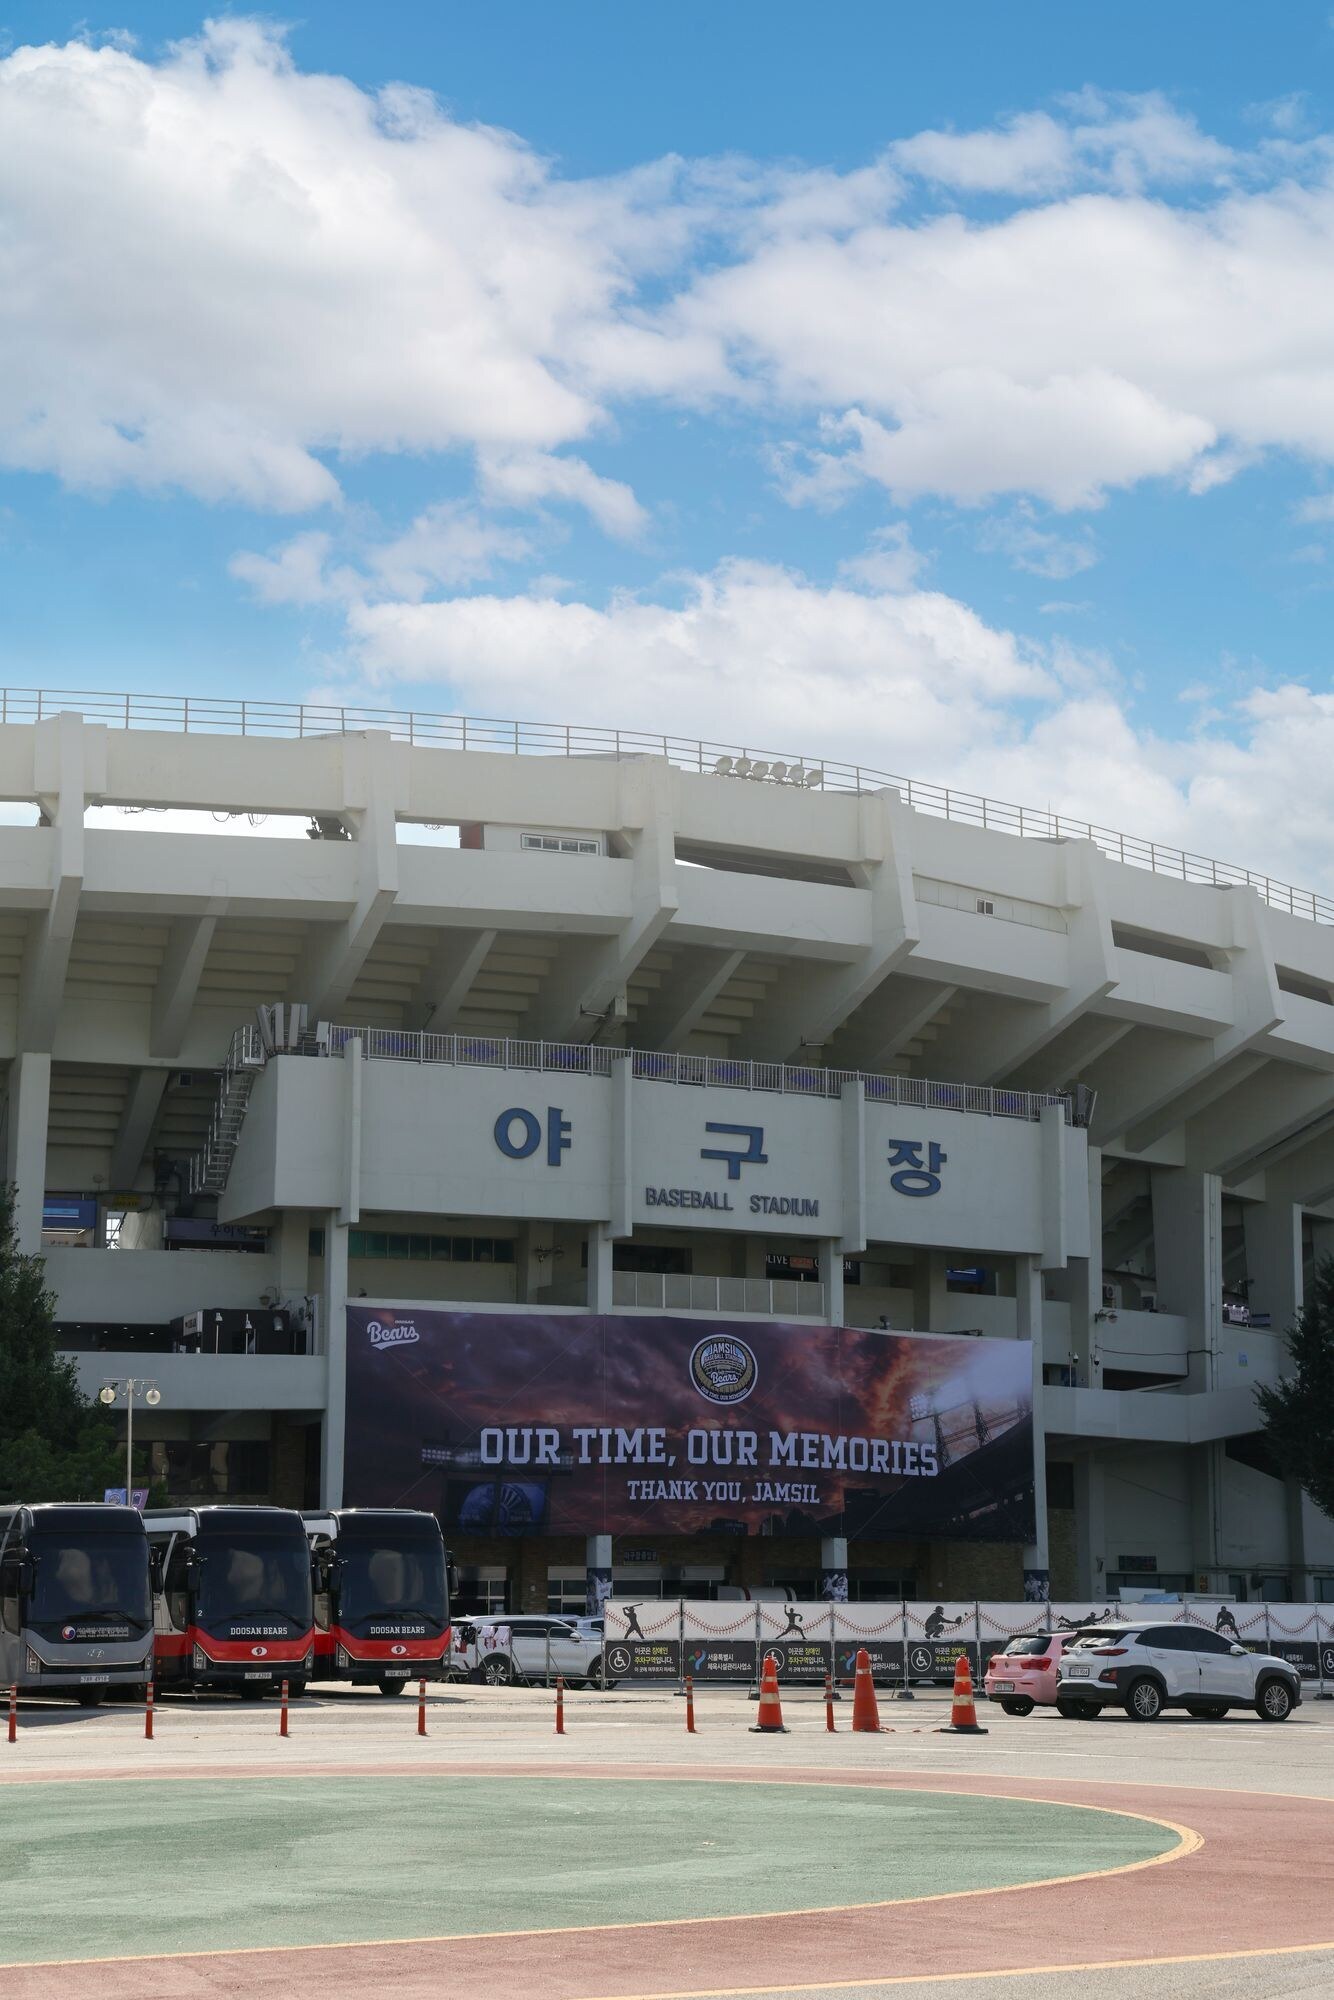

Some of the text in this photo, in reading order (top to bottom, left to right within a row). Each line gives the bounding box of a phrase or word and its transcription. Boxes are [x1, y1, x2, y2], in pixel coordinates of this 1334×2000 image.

[494, 1106, 947, 1197] 야 구 장
[645, 1187, 819, 1218] BASEBALL STADIUM
[367, 1321, 420, 1350] Bears
[709, 1343, 737, 1355] JAMSIL
[710, 1371, 739, 1387] Bears
[480, 1428, 939, 1477] OUR TIME, OUR MEMORIES
[627, 1480, 820, 1504] THANK YOU, JAMSIL
[197, 1609, 203, 1617] 2
[337, 1609, 343, 1617] 3
[230, 1627, 288, 1635] DOOSAN BEARS
[370, 1626, 425, 1634] DOOSAN BEARS
[634, 1647, 668, 1655] 이곳은 장애인
[787, 1647, 821, 1655] 이곳은 장애인
